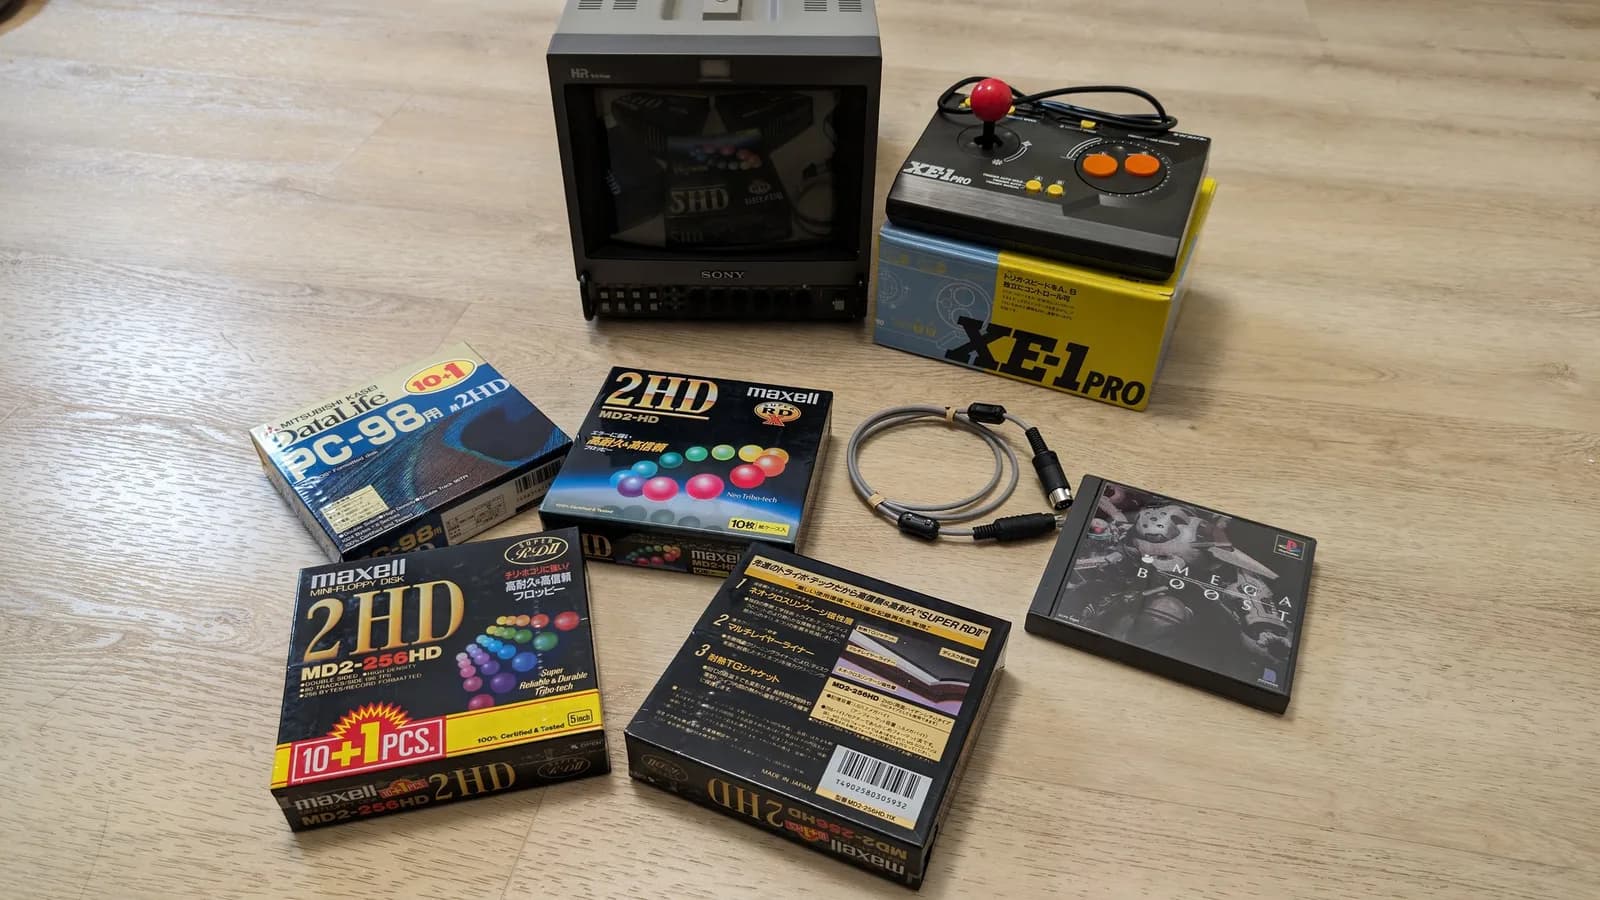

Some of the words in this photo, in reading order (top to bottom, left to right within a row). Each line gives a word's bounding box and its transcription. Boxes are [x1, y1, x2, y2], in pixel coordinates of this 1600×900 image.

[571, 68, 589, 79] HR
[904, 161, 955, 182] XE-1
[950, 175, 972, 185] PRO
[701, 270, 745, 280] SONY
[946, 315, 1089, 390] XE-1
[1082, 371, 1146, 406] PRO
[412, 362, 465, 392] 10+1
[605, 372, 718, 414] 2HD
[747, 387, 819, 404] maxell
[280, 400, 343, 429] MITSUBISHI
[345, 385, 378, 401] KASEI
[598, 410, 660, 424] MD2-HD
[731, 520, 755, 529] 10枚
[691, 550, 740, 565] maxel
[311, 558, 406, 589] maxell
[736, 578, 747, 588] 1
[310, 580, 376, 597] MINI-FLOPPY
[380, 576, 405, 586] DISK
[513, 586, 566, 601] フロッピー
[303, 580, 465, 663] 2HD
[713, 614, 729, 626] 2
[695, 644, 711, 656] 3
[725, 622, 815, 657] マルチレイヤーライナー
[301, 645, 442, 681] MD2-256HD
[540, 668, 564, 677] Super
[337, 673, 358, 683] SIDED
[520, 679, 550, 690] Reliable
[558, 672, 588, 683] Durable
[831, 681, 879, 701] MD2-256HD
[570, 715, 577, 724] 5
[577, 713, 591, 722] inch
[478, 736, 498, 744] 100%
[501, 729, 533, 740] Certified
[541, 724, 565, 732] Tested
[429, 762, 516, 800] 2HD
[760, 768, 780, 779] MADE
[789, 779, 812, 791] JAPAN
[295, 784, 378, 810] maxell
[708, 777, 783, 828] 2HD
[835, 778, 907, 809] T4902580305932
[301, 795, 429, 826] MD2-256HD
[831, 839, 905, 875] maxell
